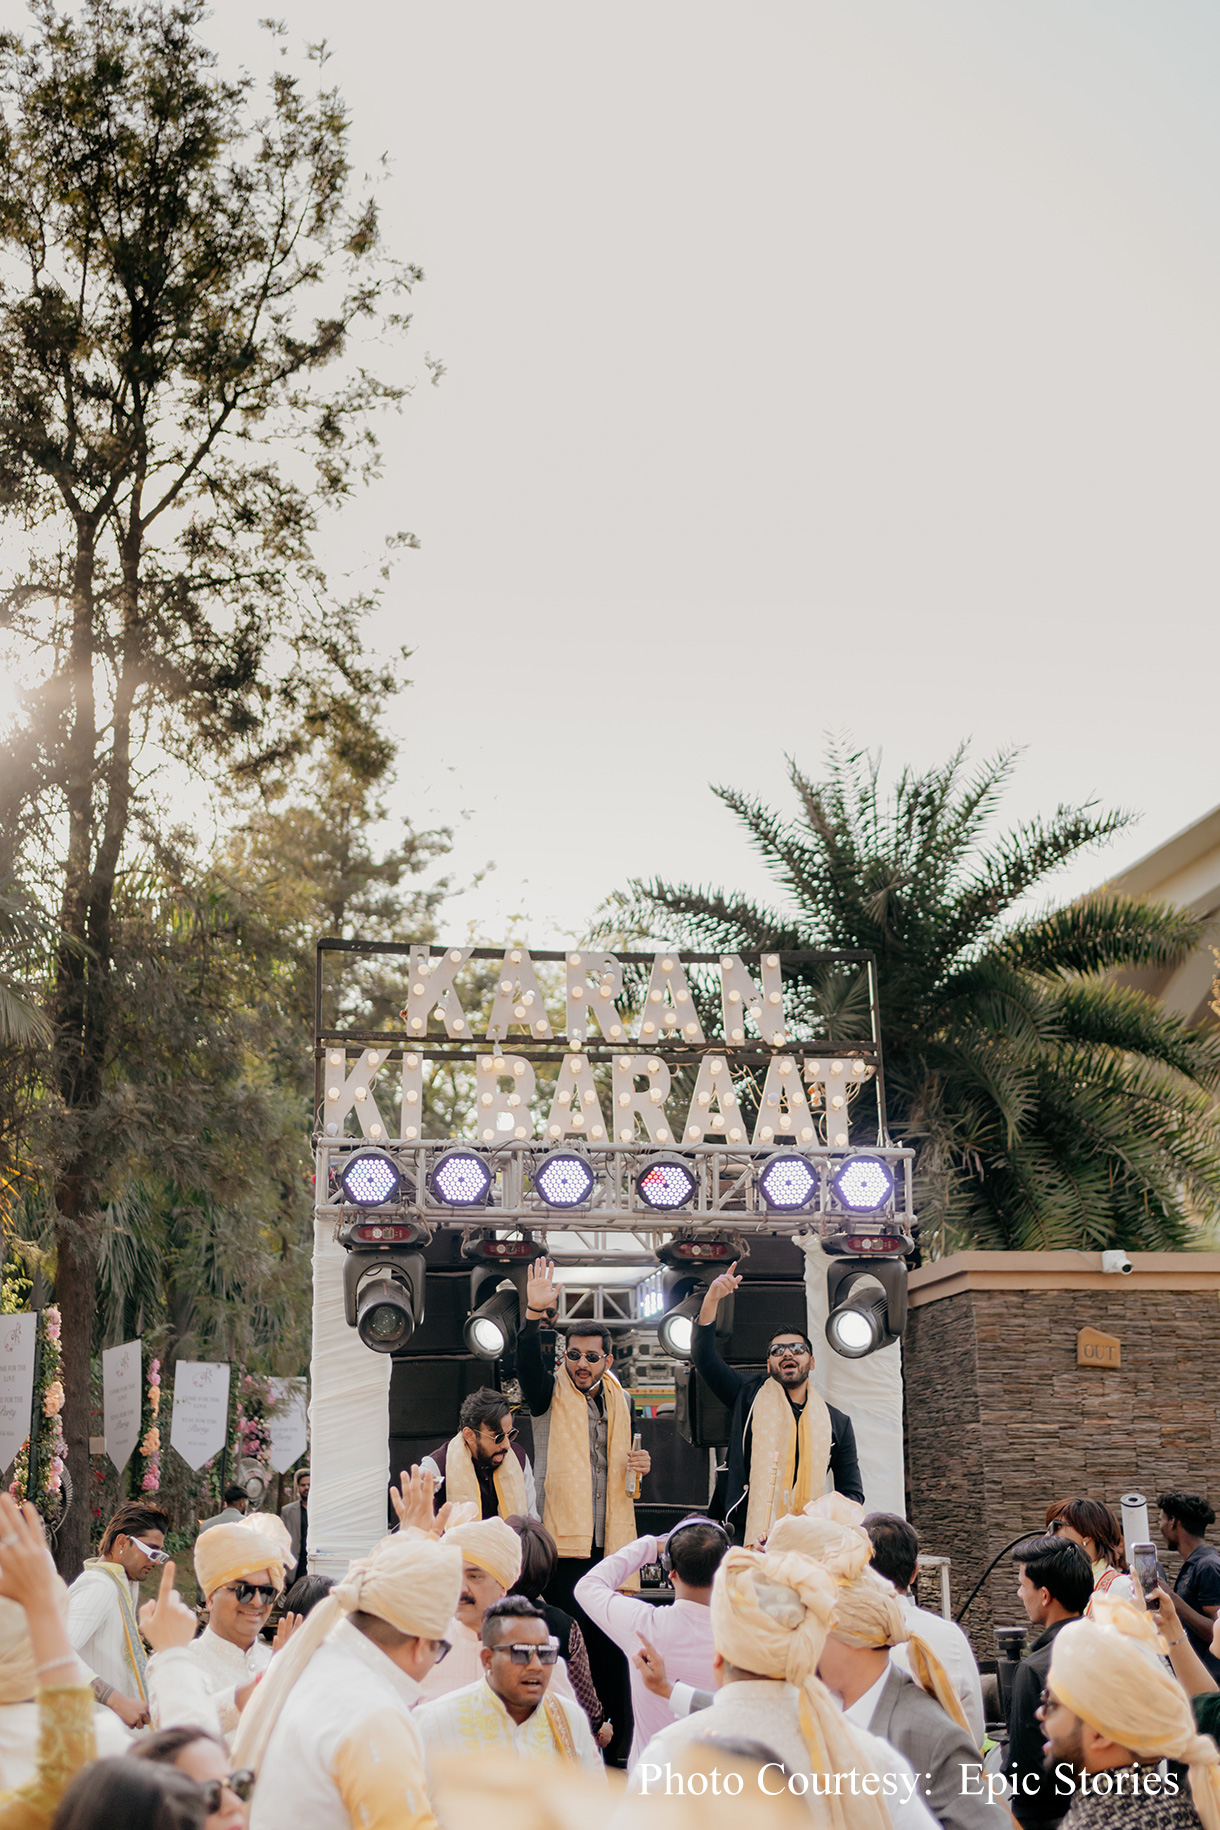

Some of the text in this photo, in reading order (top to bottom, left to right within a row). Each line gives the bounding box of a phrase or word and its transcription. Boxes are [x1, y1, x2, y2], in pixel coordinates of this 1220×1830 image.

[405, 945, 786, 1046] KARAN
[324, 1047, 867, 1147] KI BARAAT
[1083, 1343, 1117, 1361] OUT
